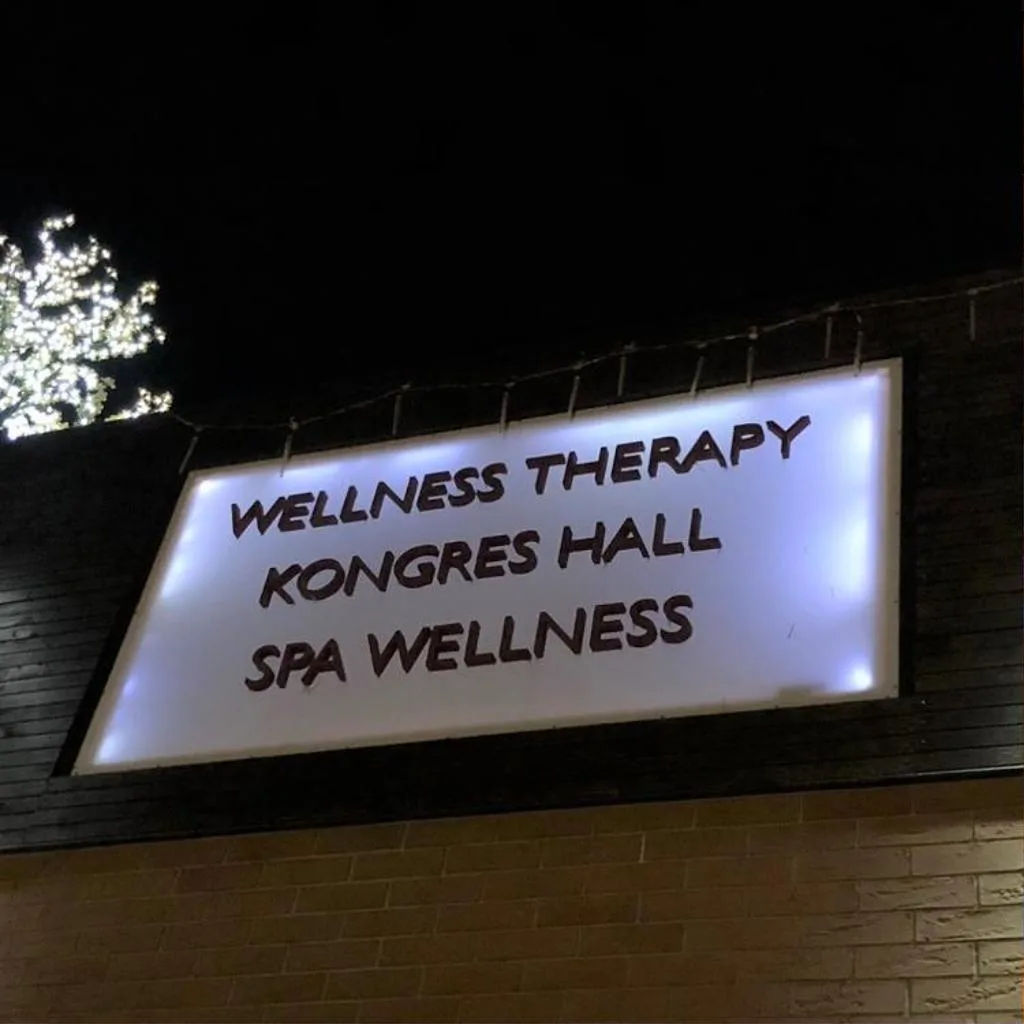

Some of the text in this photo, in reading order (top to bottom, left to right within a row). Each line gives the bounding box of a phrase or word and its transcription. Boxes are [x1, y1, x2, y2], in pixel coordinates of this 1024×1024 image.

[231, 415, 811, 539] WELLNESS THERAPY
[259, 508, 722, 607] KONGRES HALL
[245, 594, 694, 692] SPA WELLNESS
